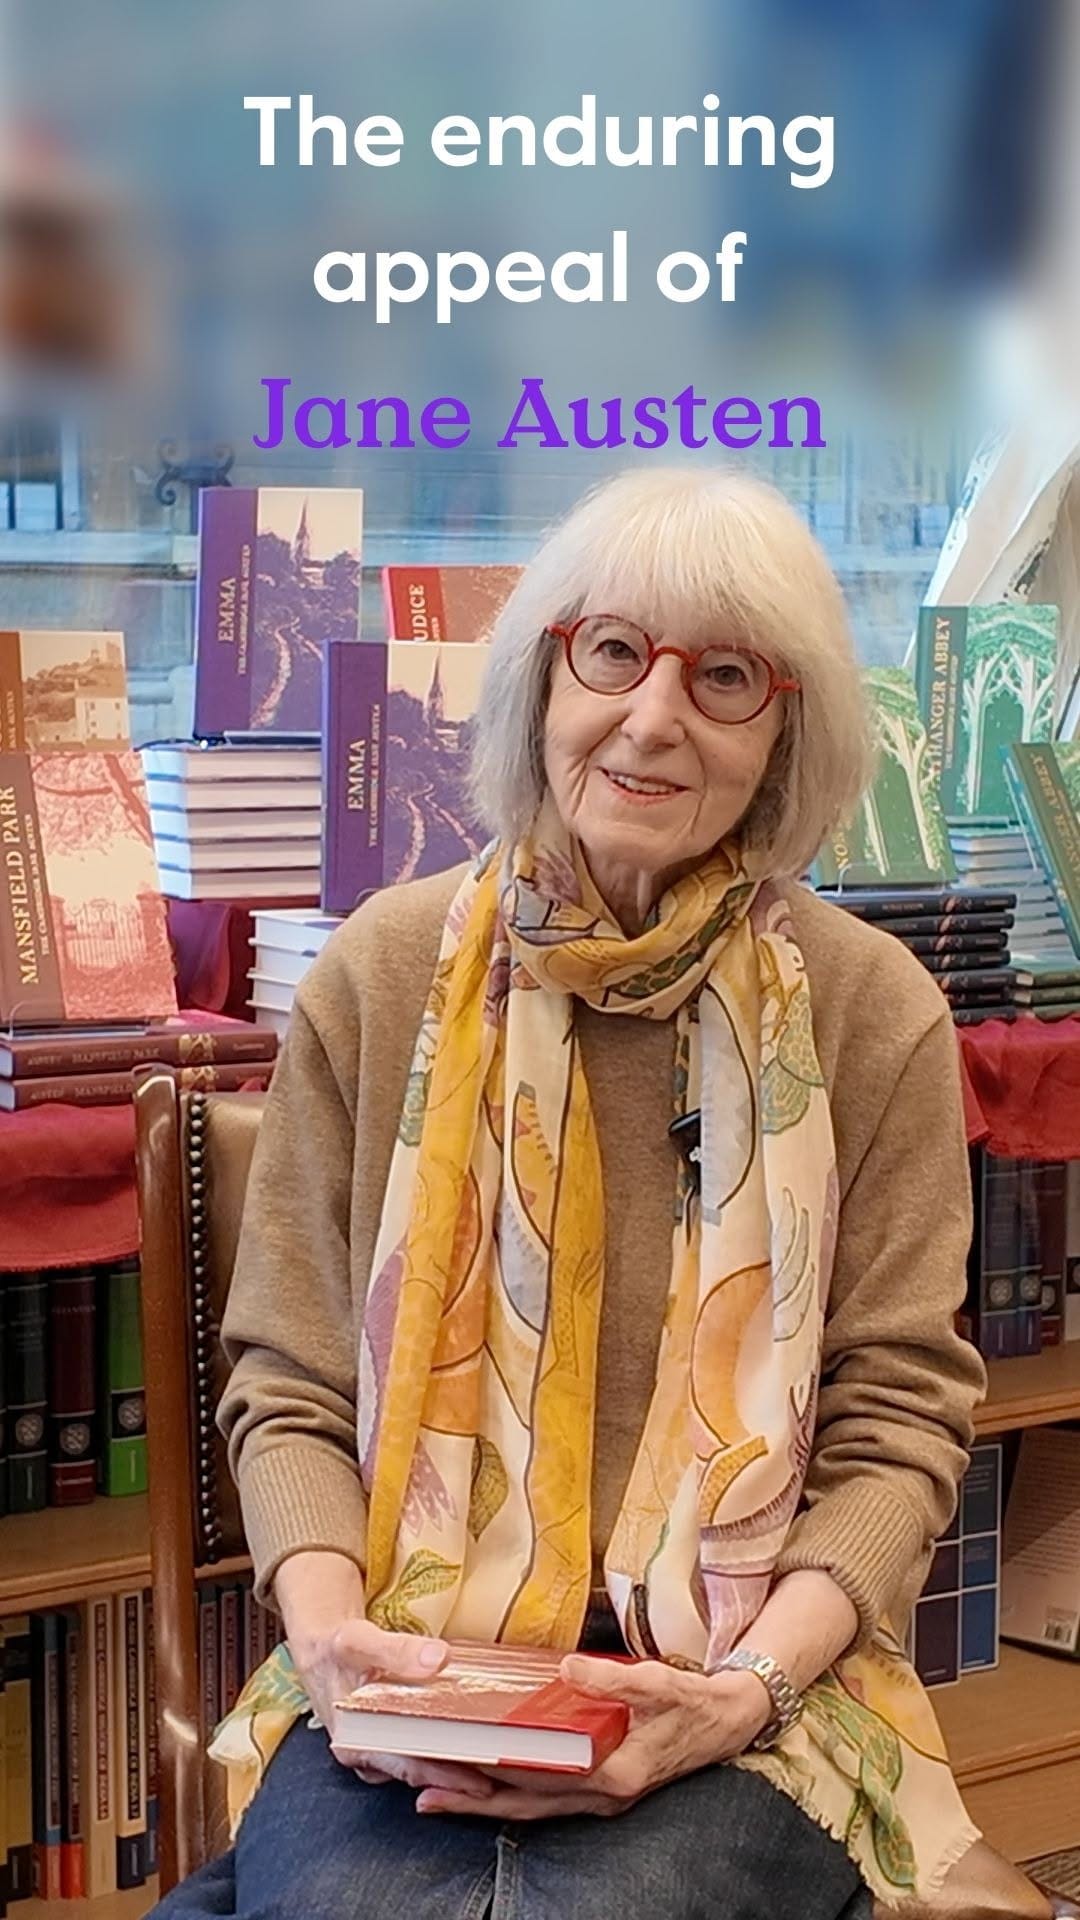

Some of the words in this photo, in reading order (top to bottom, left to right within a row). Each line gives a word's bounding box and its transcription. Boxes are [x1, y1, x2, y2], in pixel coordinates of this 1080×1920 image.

[217, 577, 237, 642] EMMA
[932, 616, 952, 675] ABBEY
[927, 677, 947, 758] HANGER
[347, 738, 366, 811] EMMA
[0, 785, 20, 844] PARK
[5, 850, 40, 985] MANSFIELD
